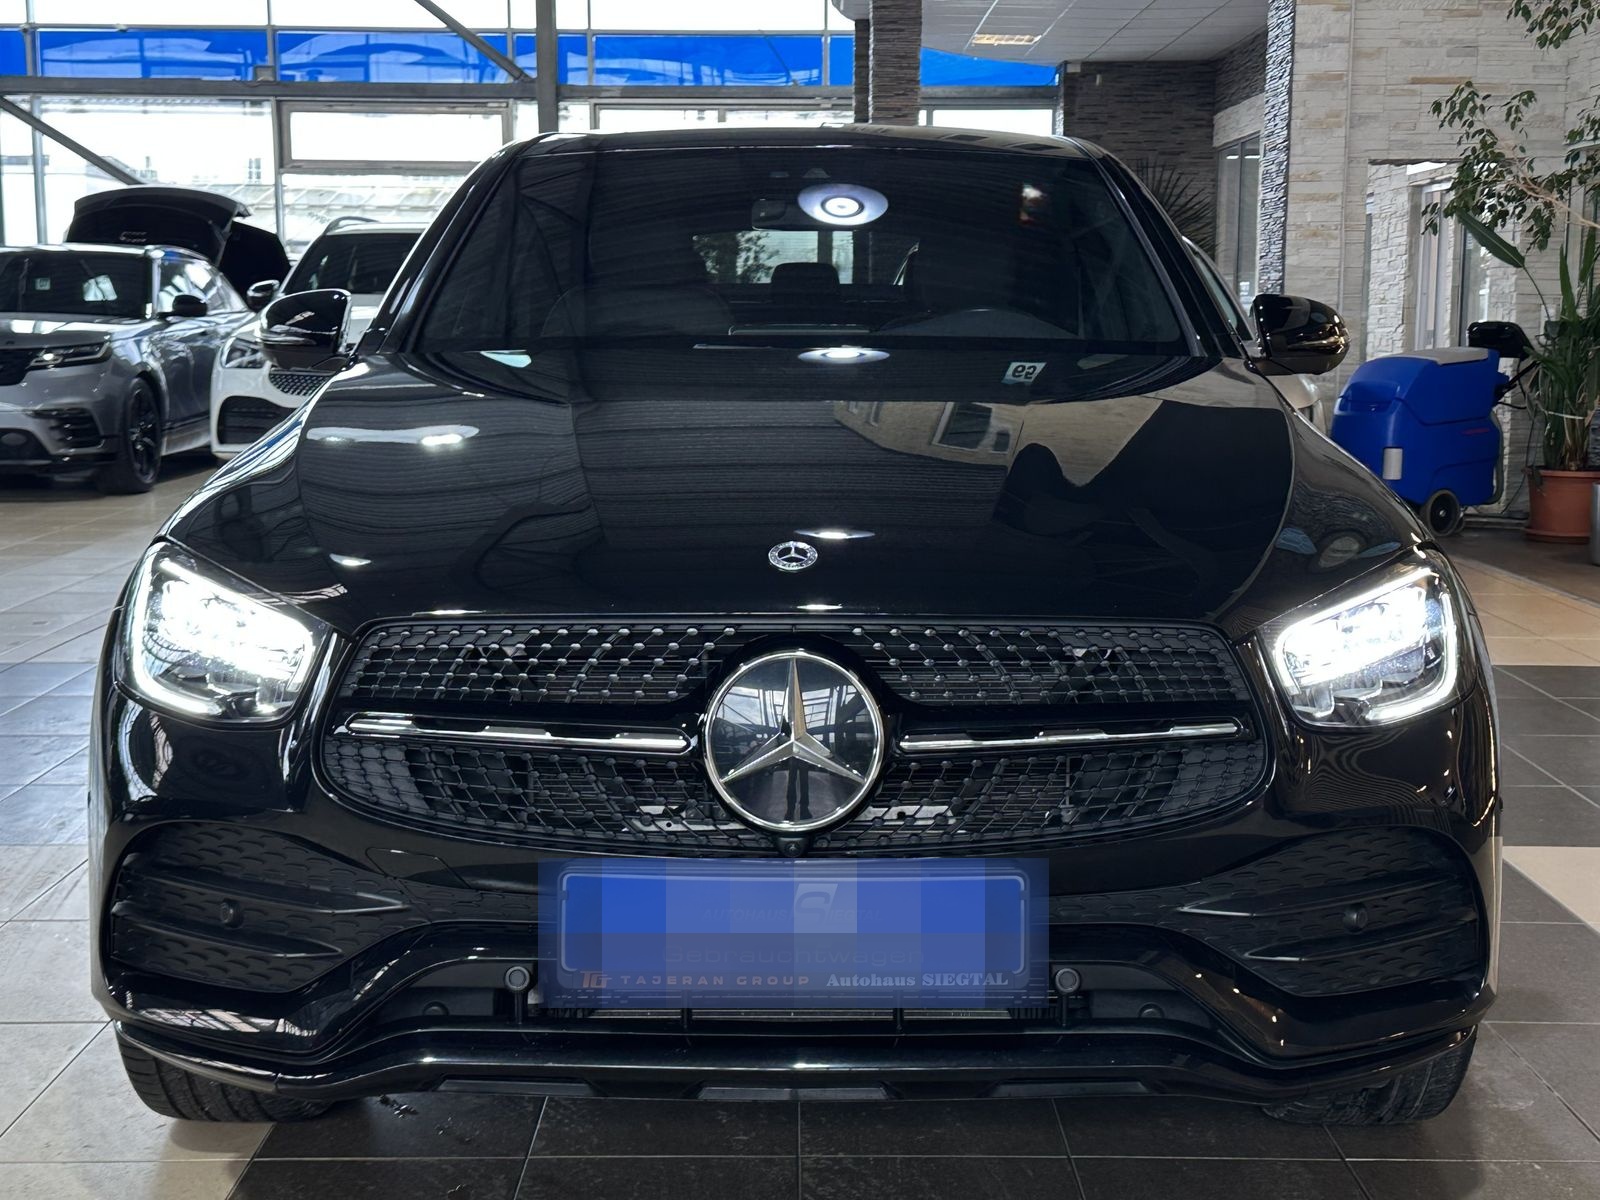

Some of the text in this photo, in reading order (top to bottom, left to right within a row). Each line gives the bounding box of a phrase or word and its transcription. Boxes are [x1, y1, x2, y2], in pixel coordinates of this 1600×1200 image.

[701, 909, 787, 922] AUTOHAUS
[662, 945, 925, 966] Gebrauchtwagen
[620, 975, 724, 985] TAJERAN
[736, 975, 810, 985] GROUP
[826, 973, 916, 987] Autohaus
[922, 972, 1009, 987] SIEGTAL
